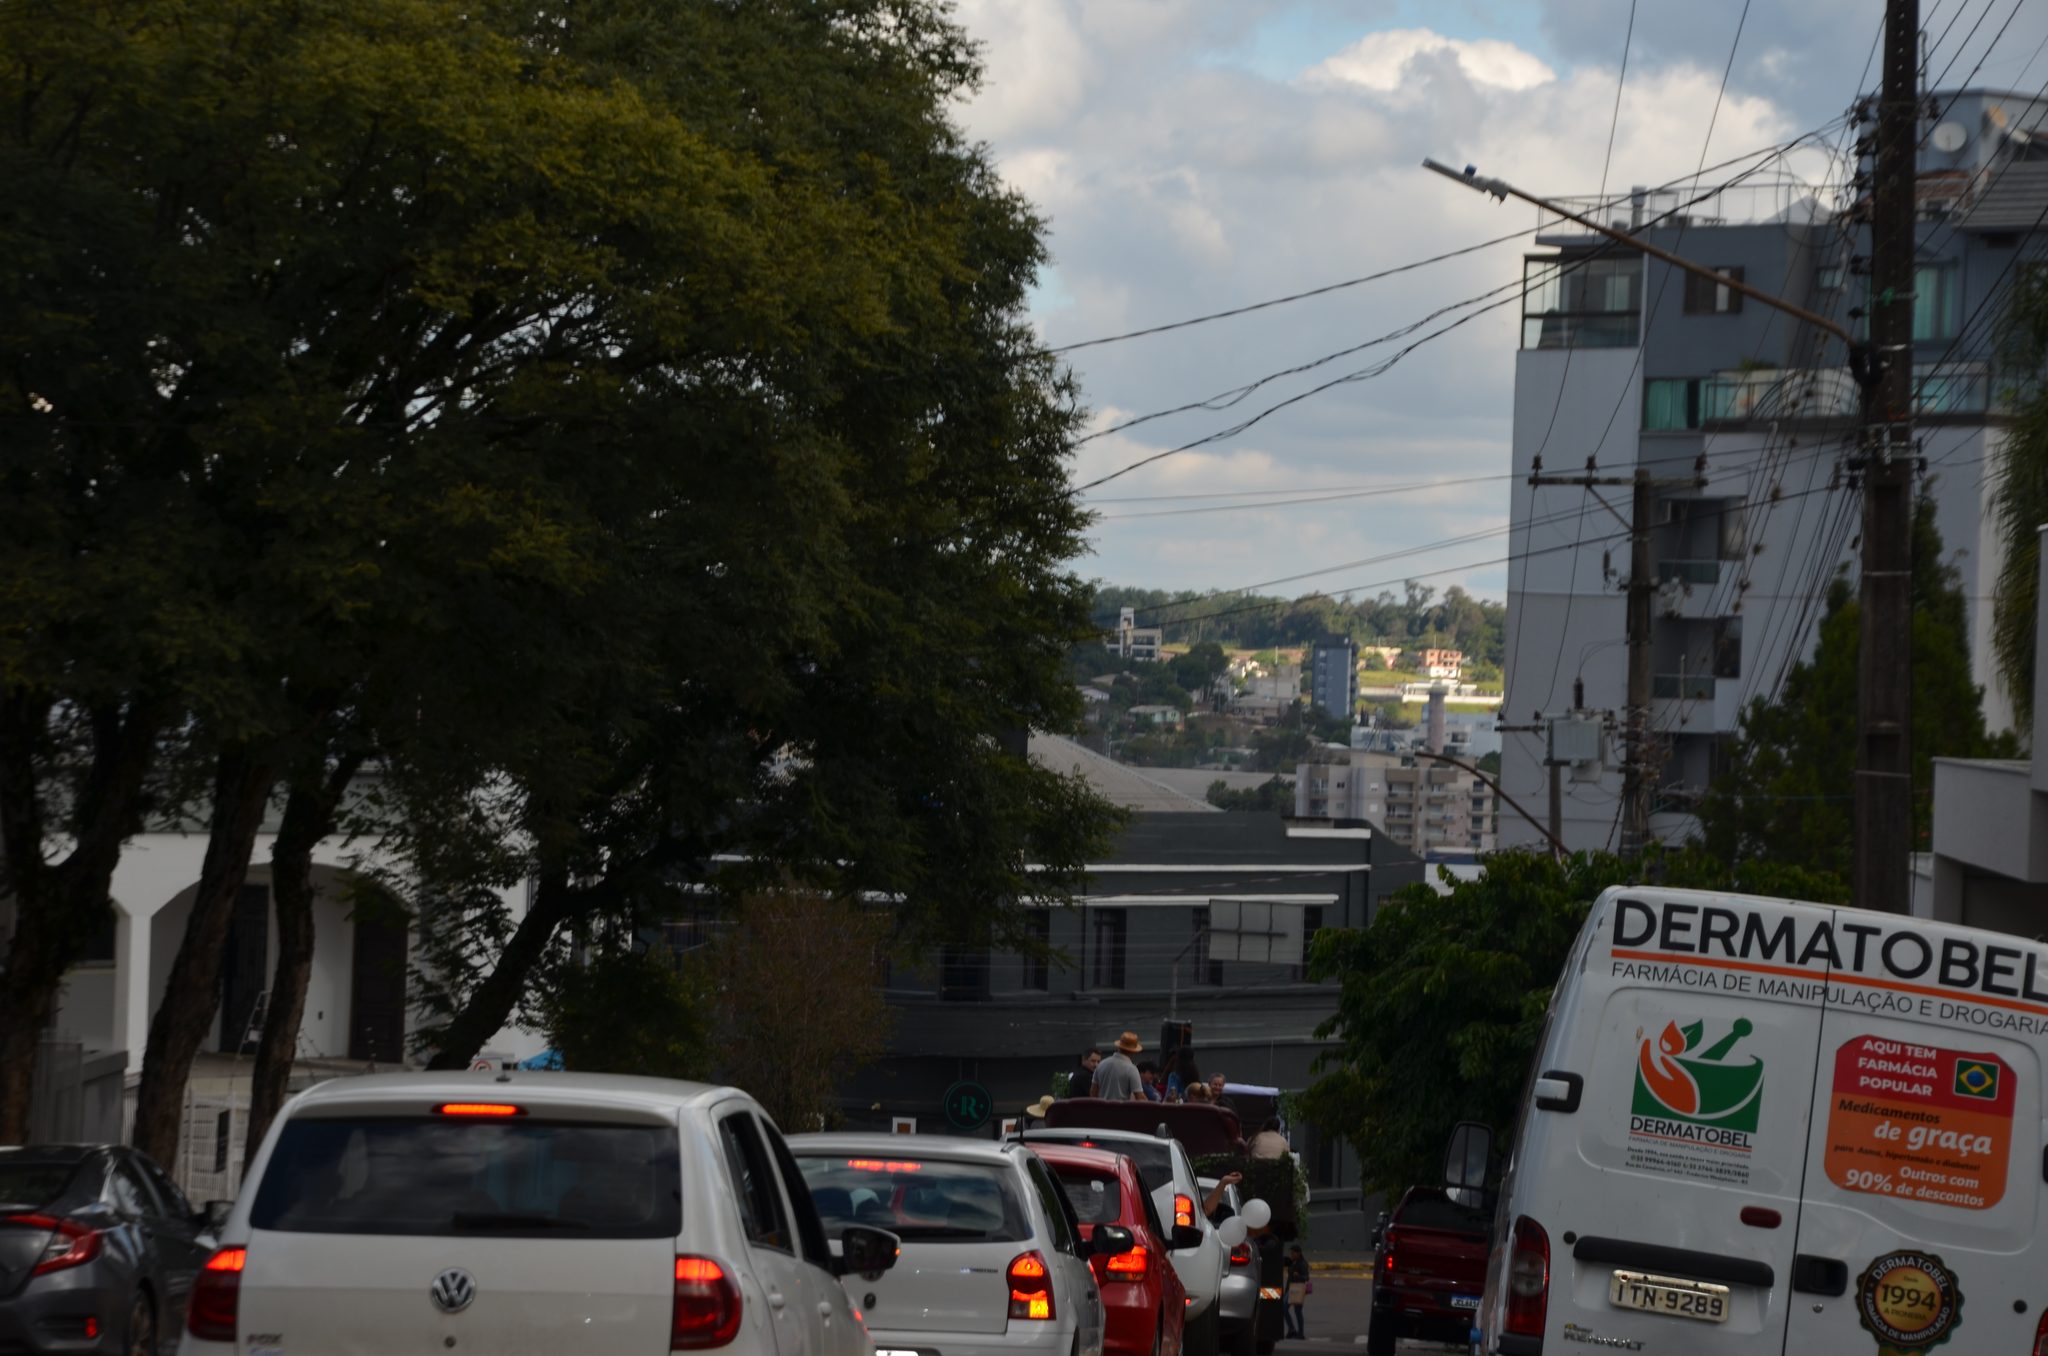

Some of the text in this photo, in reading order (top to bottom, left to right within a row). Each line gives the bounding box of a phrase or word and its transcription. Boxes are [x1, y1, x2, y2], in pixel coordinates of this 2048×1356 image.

[1612, 898, 2048, 1003] DERMATOBEL
[1611, 961, 1718, 989] FARMÁCIA
[1723, 973, 1751, 993] DE
[1758, 978, 1913, 1013] MANIPULAÇÃO
[1919, 999, 1934, 1016] E
[1862, 1039, 1937, 1060] AQUI TEM
[1858, 1057, 1938, 1079] FARMÁCIA
[1859, 1075, 1933, 1096] POPULAR
[1838, 1099, 1941, 1125] Medicamentos
[1630, 1116, 1753, 1149] DERMATOBEL
[1874, 1121, 1993, 1157] de graça
[1845, 1168, 1985, 1207] 90% de descontos
[1900, 1165, 1980, 1189] Outros com
[1872, 1256, 1949, 1292] DERMATOBEL
[1882, 1283, 1936, 1311] 1994
